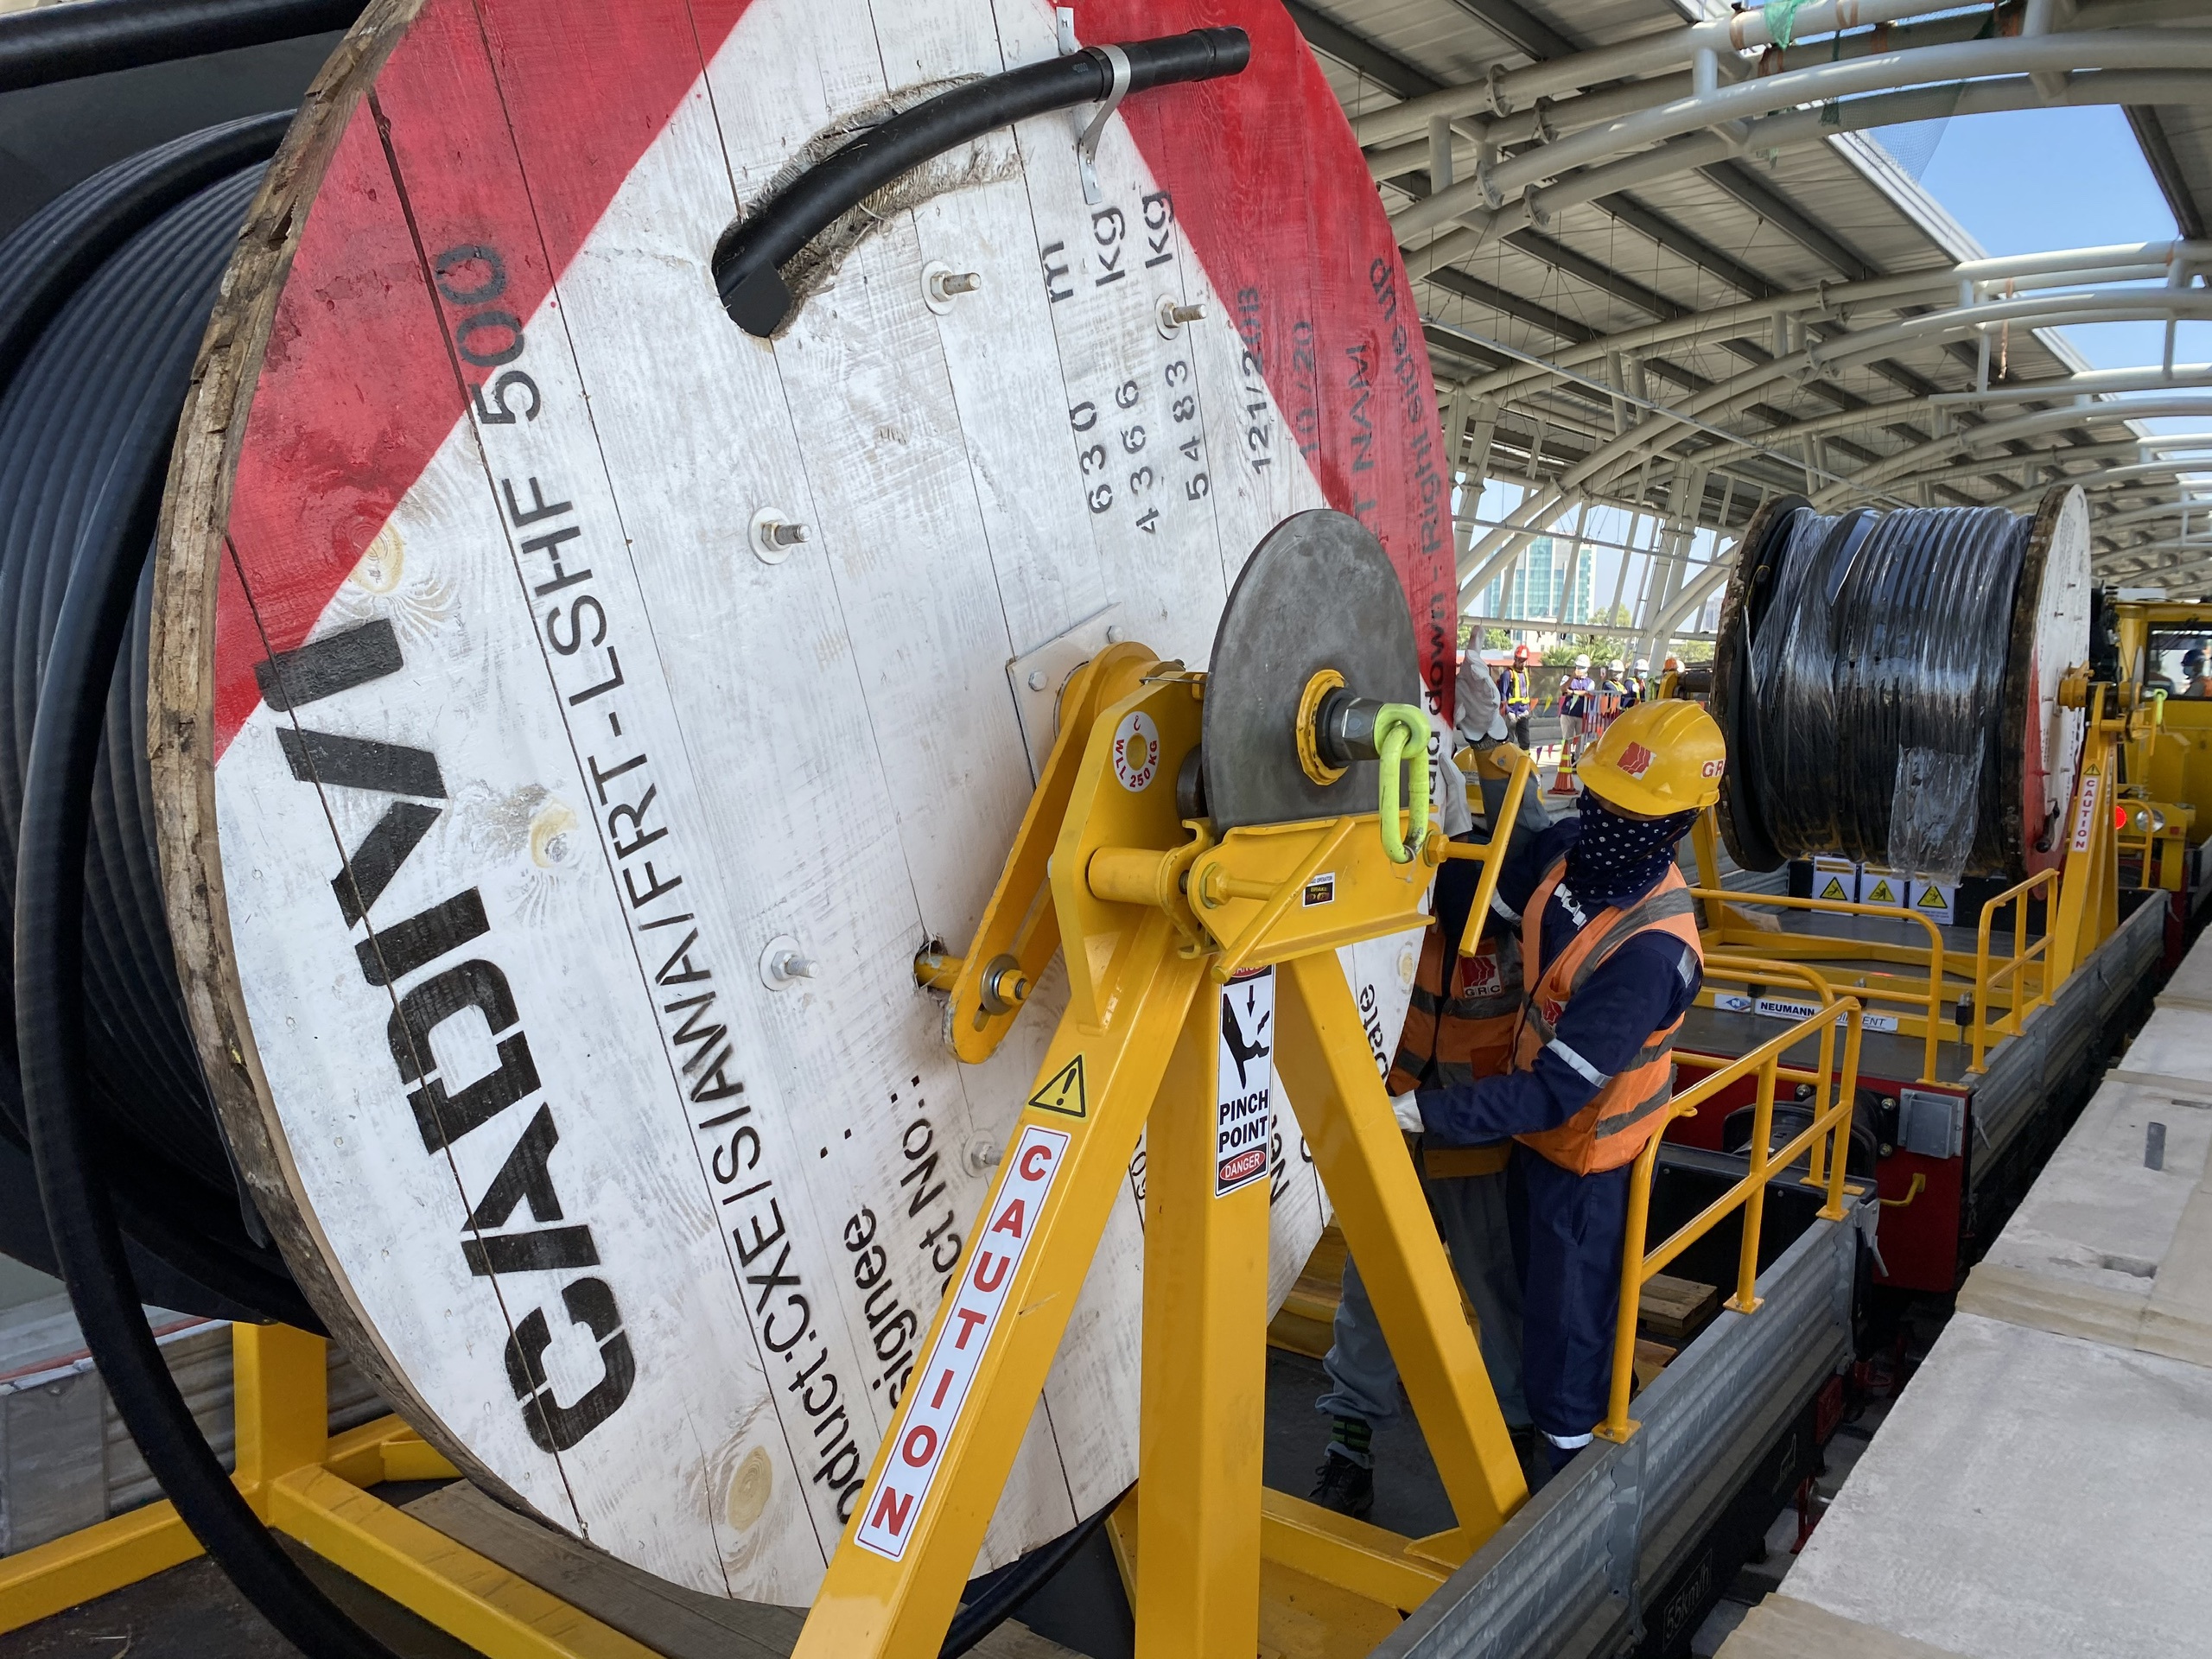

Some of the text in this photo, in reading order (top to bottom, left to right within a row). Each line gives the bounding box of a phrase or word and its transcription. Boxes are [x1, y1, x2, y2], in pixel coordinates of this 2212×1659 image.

[1370, 257, 1396, 322] up
[434, 244, 541, 424] 500
[1141, 189, 1210, 501] 5483 kg
[1042, 241, 1113, 514] 630 m
[1092, 206, 1159, 534] 4366 kg
[1425, 593, 1445, 715] down
[1116, 739, 1157, 787] WLL 250 KG
[1702, 760, 1724, 778] GR
[2075, 779, 2096, 849] CAUTION
[1465, 985, 1501, 996] GRC
[1760, 1001, 1815, 1017] NEUMANN
[253, 618, 636, 1452] CADIVI
[1218, 1115, 1268, 1154] POINT
[1219, 1088, 1268, 1125] PINCH
[1224, 1151, 1261, 1179] DANGER
[843, 1205, 918, 1410] signee
[870, 1145, 1052, 1536] CAUTION
